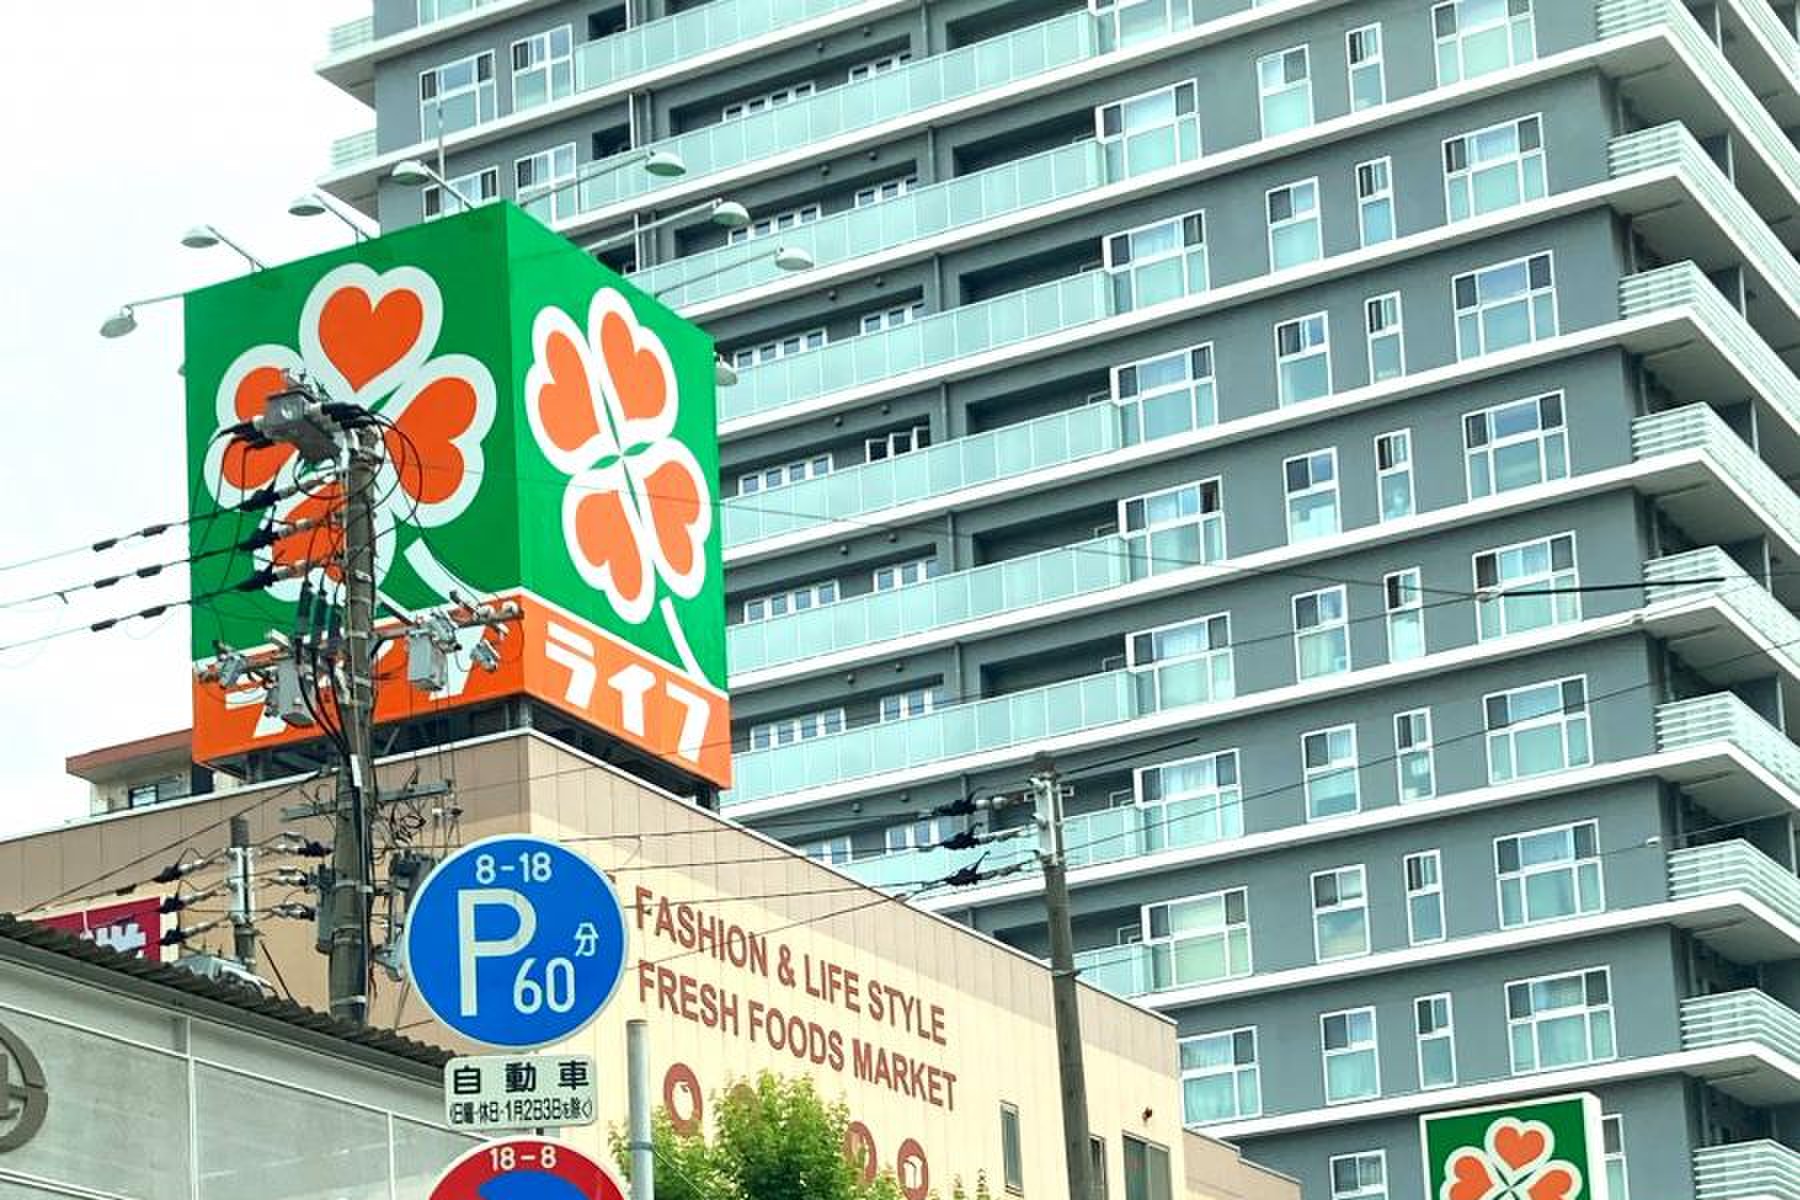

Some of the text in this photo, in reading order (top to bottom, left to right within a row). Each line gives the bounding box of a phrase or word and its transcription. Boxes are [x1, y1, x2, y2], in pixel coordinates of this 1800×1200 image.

[544, 622, 710, 763] ライフ
[475, 852, 552, 884] 8-18
[458, 888, 537, 1017] P
[636, 885, 947, 1046] FASHION & LIFE STYLE
[638, 959, 957, 1111] FRESH FOODS MARKET
[490, 1146, 557, 1171] 18-8
